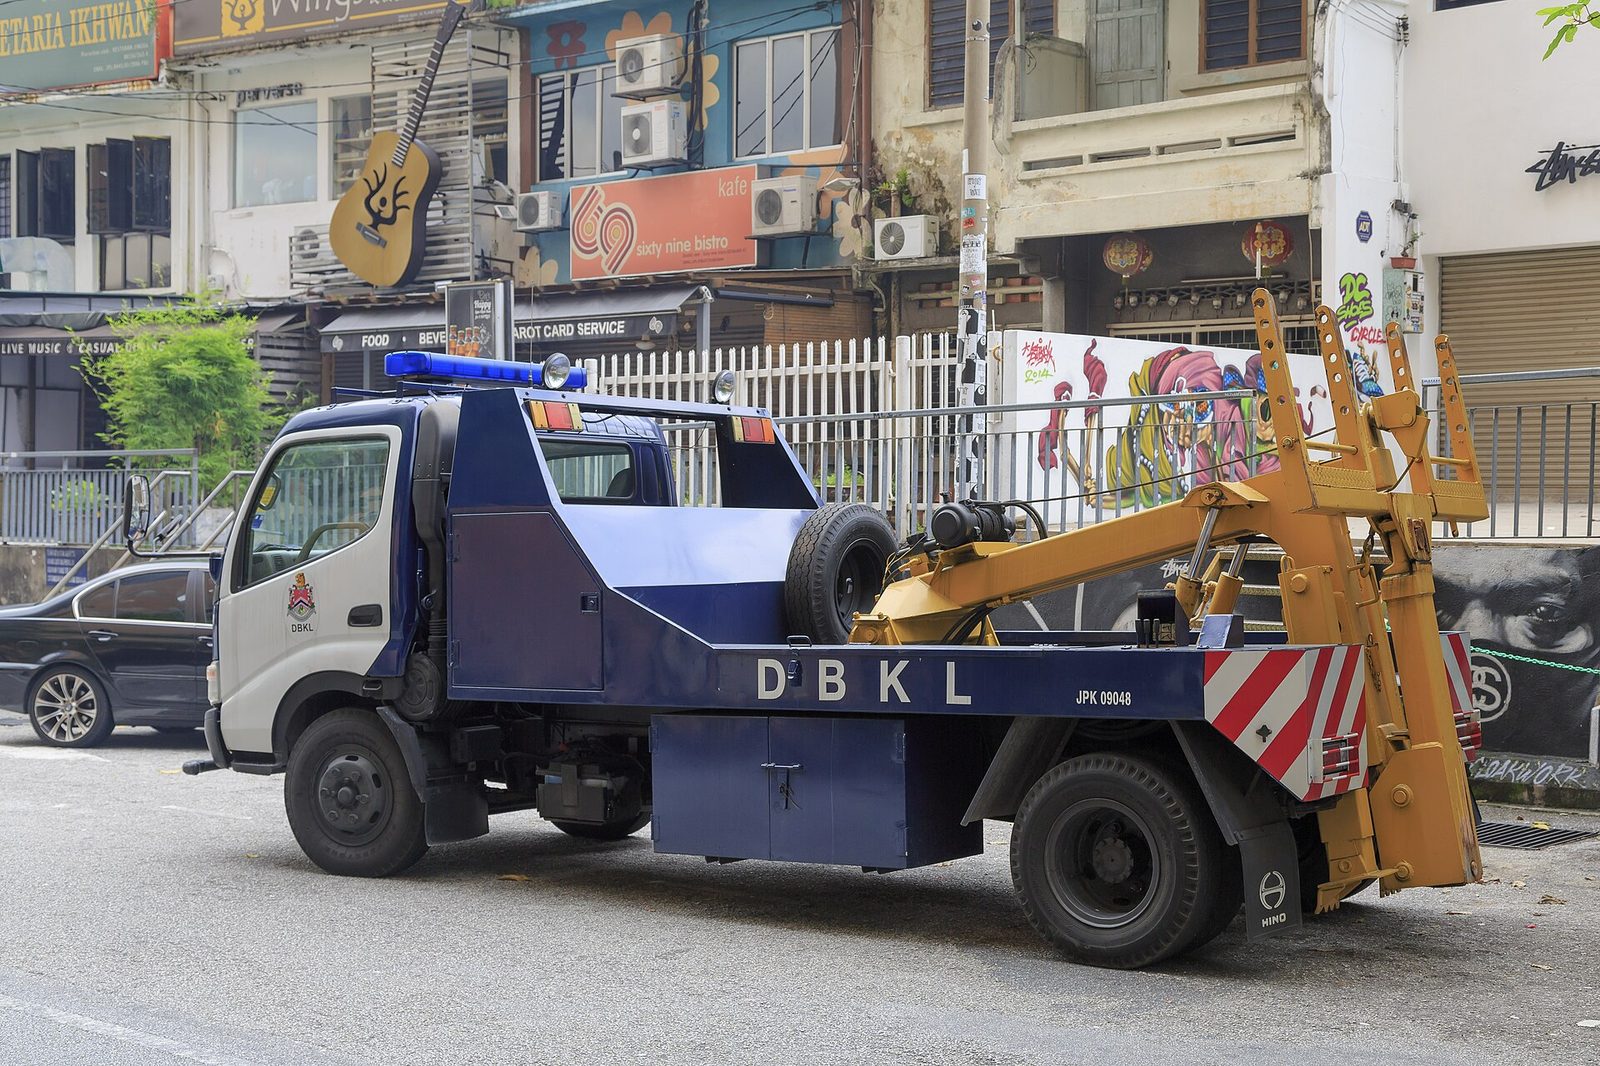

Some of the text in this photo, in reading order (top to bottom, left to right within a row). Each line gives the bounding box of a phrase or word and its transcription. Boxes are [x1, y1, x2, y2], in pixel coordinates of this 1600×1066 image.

[69, 0, 150, 47] IKHWAN
[718, 177, 748, 197] kafe
[636, 240, 662, 259] sixty
[665, 237, 692, 253] nine
[694, 234, 728, 252] bistro
[1339, 272, 1372, 306] DC
[1335, 300, 1374, 324] SHOES
[361, 334, 390, 347] FOOD
[513, 325, 541, 340] AROT
[543, 322, 574, 337] CARD
[577, 320, 625, 336] SERVICE
[1, 342, 24, 354] LIVE
[28, 342, 61, 354] MUSIC
[78, 341, 121, 354] CASUAL
[291, 623, 314, 633] DBKL
[1076, 690, 1131, 706] JPK 09048
[1261, 912, 1287, 928] HINO
